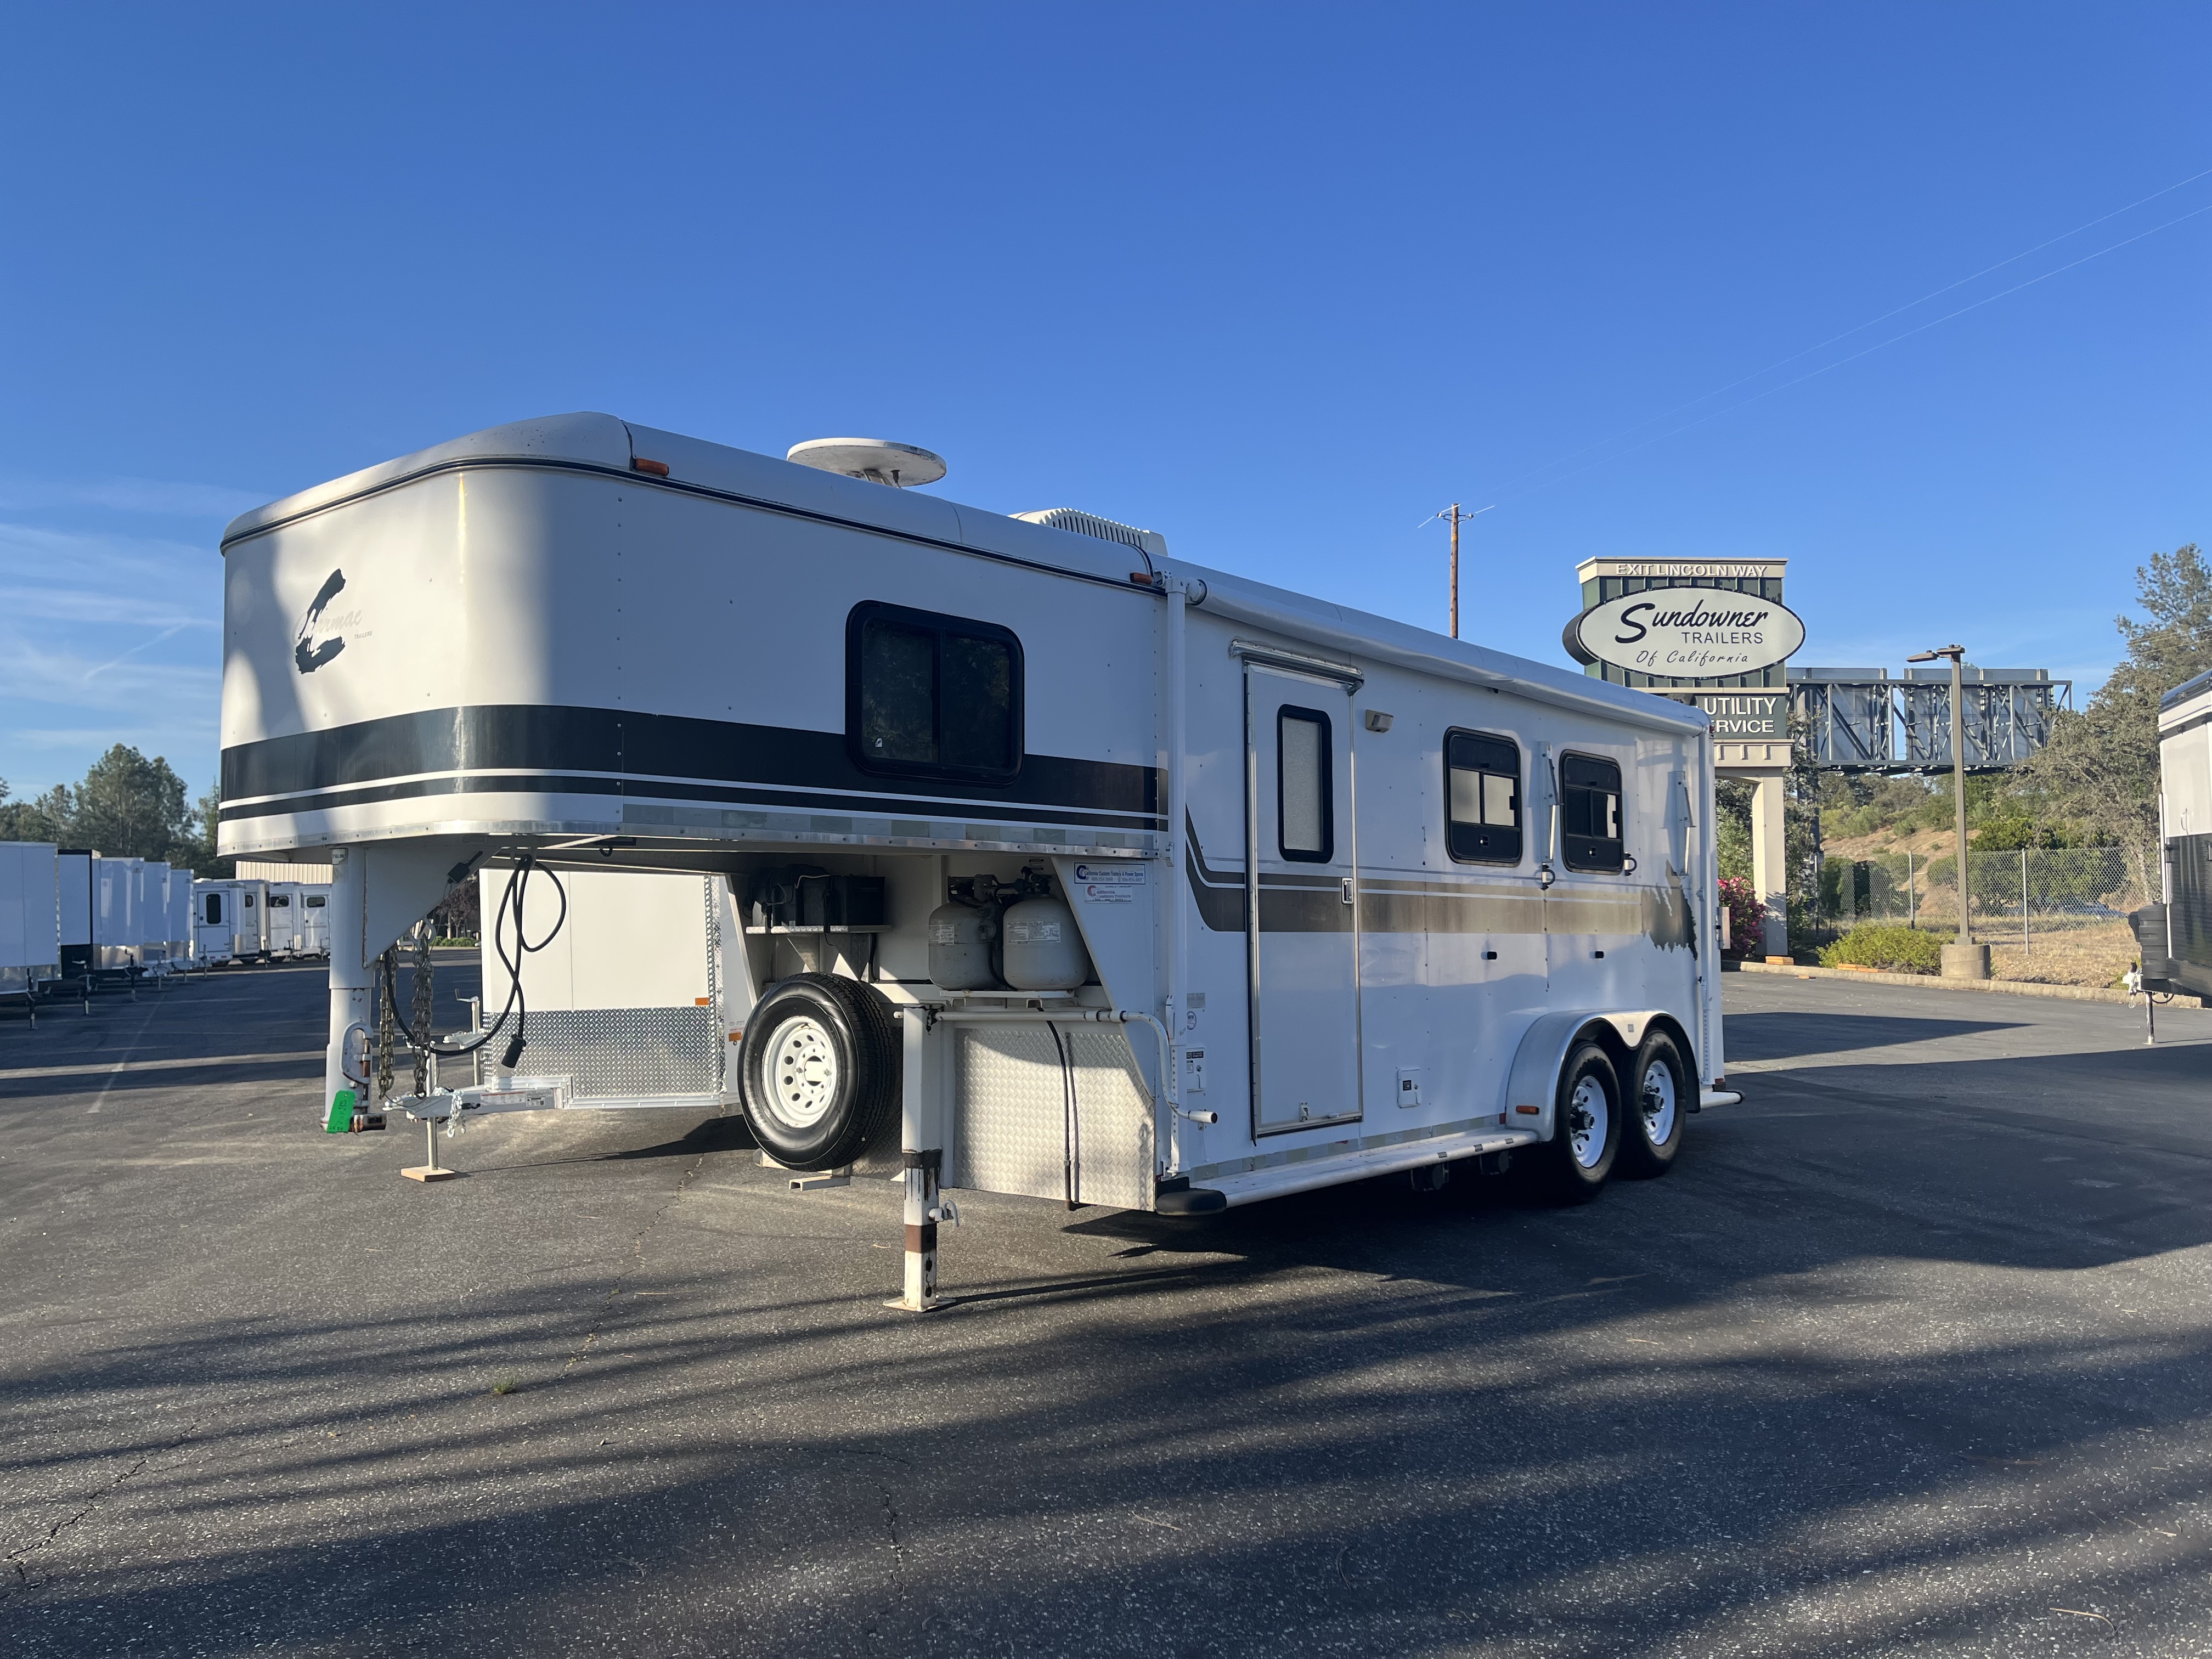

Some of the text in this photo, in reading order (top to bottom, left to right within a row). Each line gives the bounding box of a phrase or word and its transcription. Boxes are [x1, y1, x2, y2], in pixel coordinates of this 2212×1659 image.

[1616, 564, 1767, 577] EXIT LINCOLN WAY
[1615, 599, 1769, 644] Sundowner
[1681, 632, 1763, 644] TRAILERS
[1636, 650, 1748, 667] Of California
[1704, 697, 1777, 715] UTILITY
[1711, 720, 1775, 733] RVICE
